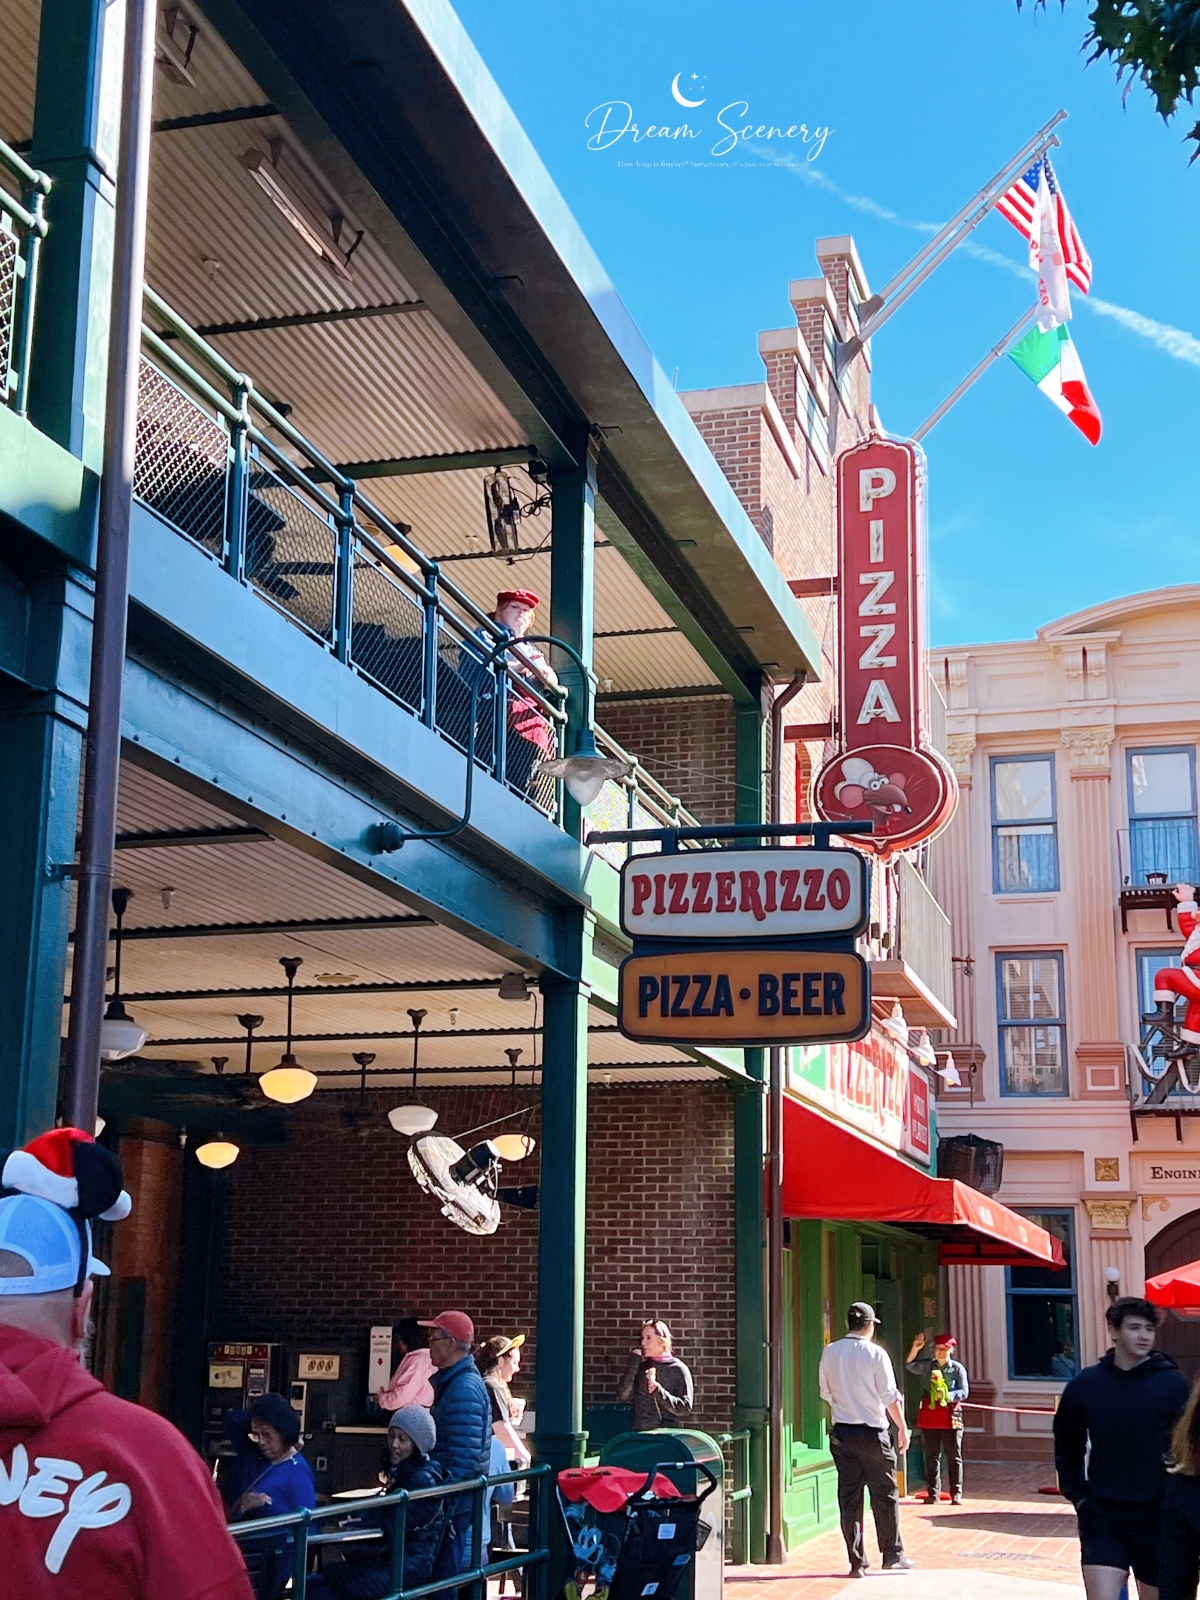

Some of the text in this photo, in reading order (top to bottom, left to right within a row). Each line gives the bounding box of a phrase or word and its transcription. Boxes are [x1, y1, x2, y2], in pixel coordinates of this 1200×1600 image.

[856, 467, 902, 725] PIZZA
[631, 868, 851, 922] PIZZERIZZO
[638, 972, 846, 1018] PIZZA BEER
